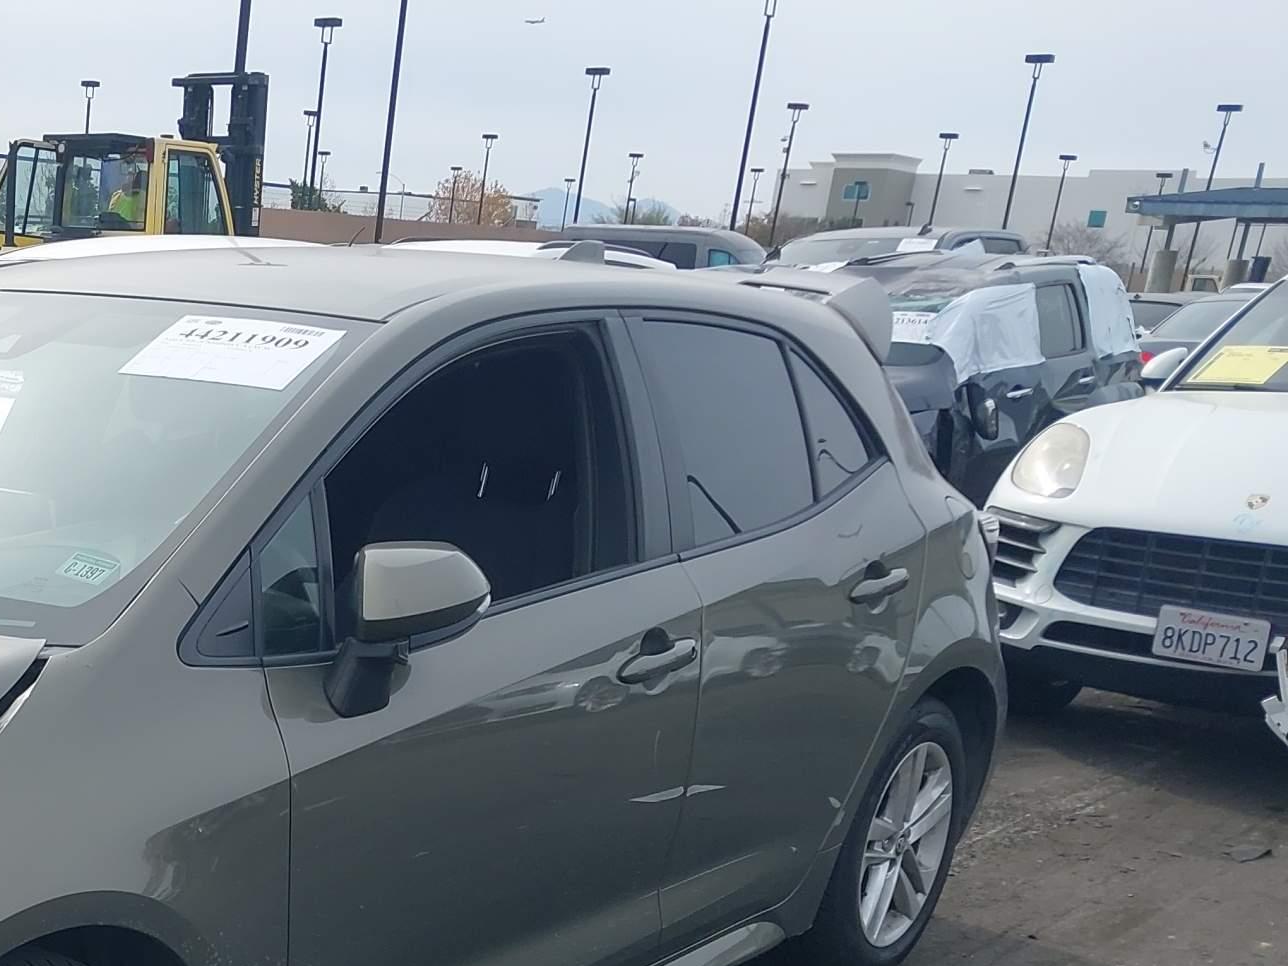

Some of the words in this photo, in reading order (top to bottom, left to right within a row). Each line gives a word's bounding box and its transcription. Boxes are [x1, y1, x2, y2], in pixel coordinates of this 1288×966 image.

[179, 327, 310, 350] 44211909
[64, 560, 106, 581] C-1397
[1161, 626, 1259, 664] 8KDP712
